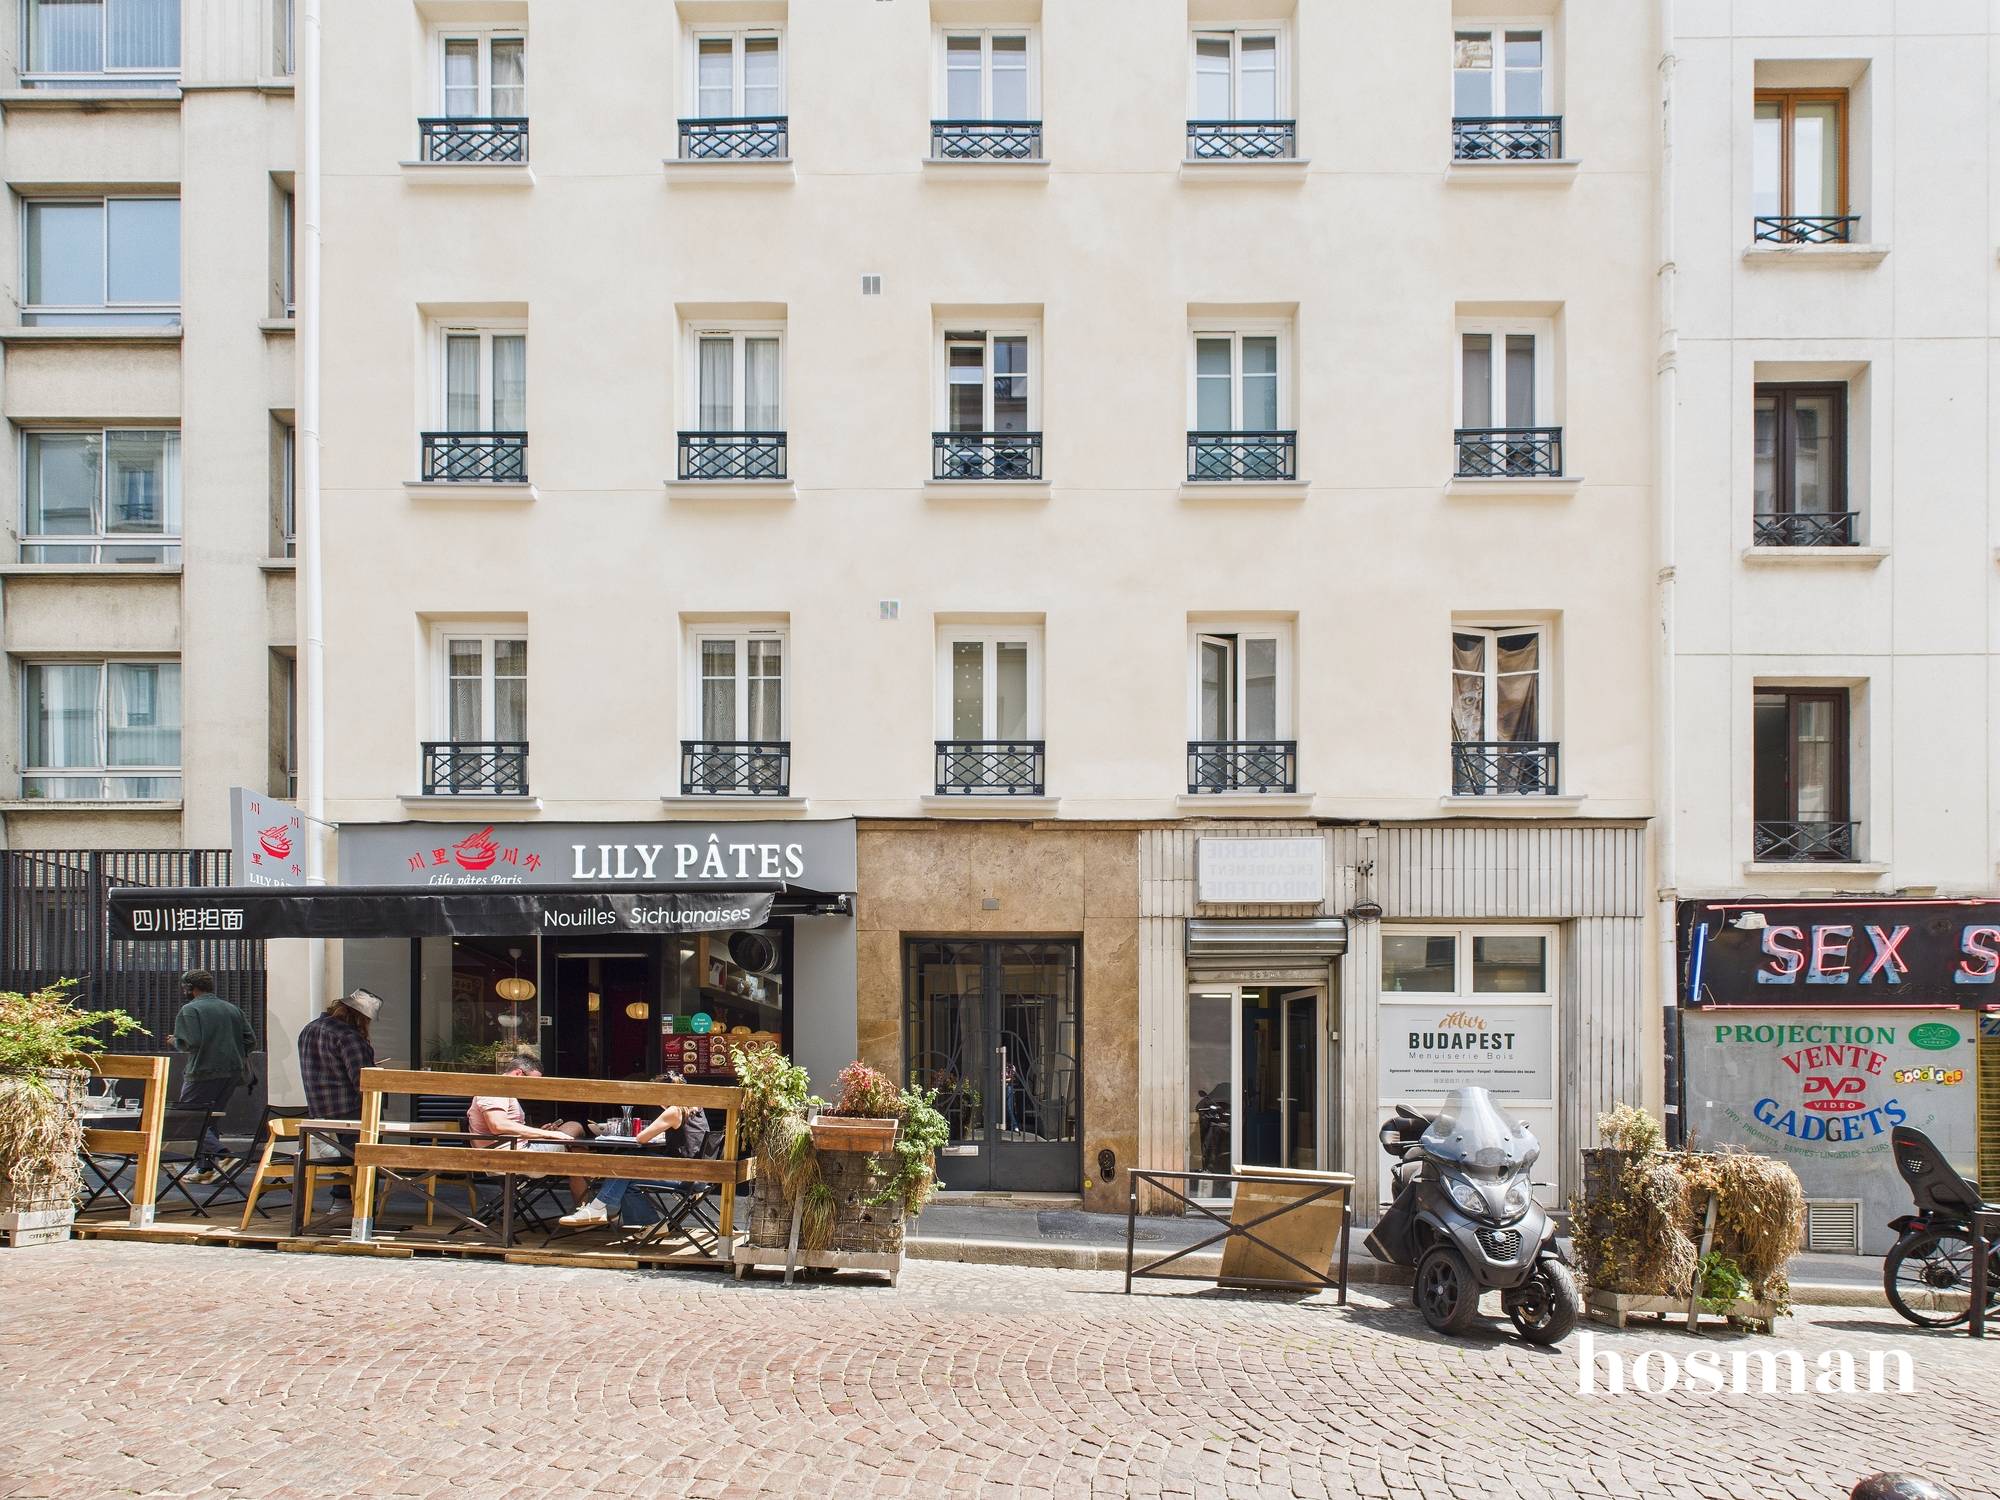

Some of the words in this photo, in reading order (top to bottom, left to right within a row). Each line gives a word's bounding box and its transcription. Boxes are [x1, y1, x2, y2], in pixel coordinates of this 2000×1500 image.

[571, 844, 664, 880] LILY
[673, 832, 804, 880] PÂTES
[249, 872, 272, 887] LILY
[490, 874, 523, 886] Paris
[132, 907, 244, 932] 四川担担面
[543, 907, 616, 927] Nouilles
[630, 906, 751, 925] Sichuanaises
[1757, 924, 1910, 985] SEX
[1408, 1032, 1516, 1050] BUDAPEST
[1714, 1025, 1897, 1048] PROJECTION
[1408, 1052, 1479, 1060] Menuiserie
[1487, 1052, 1514, 1060] Bois
[1781, 1044, 1888, 1076] VENTE
[1803, 1076, 1867, 1100] DVD
[1753, 1098, 1907, 1143] GADGETS
